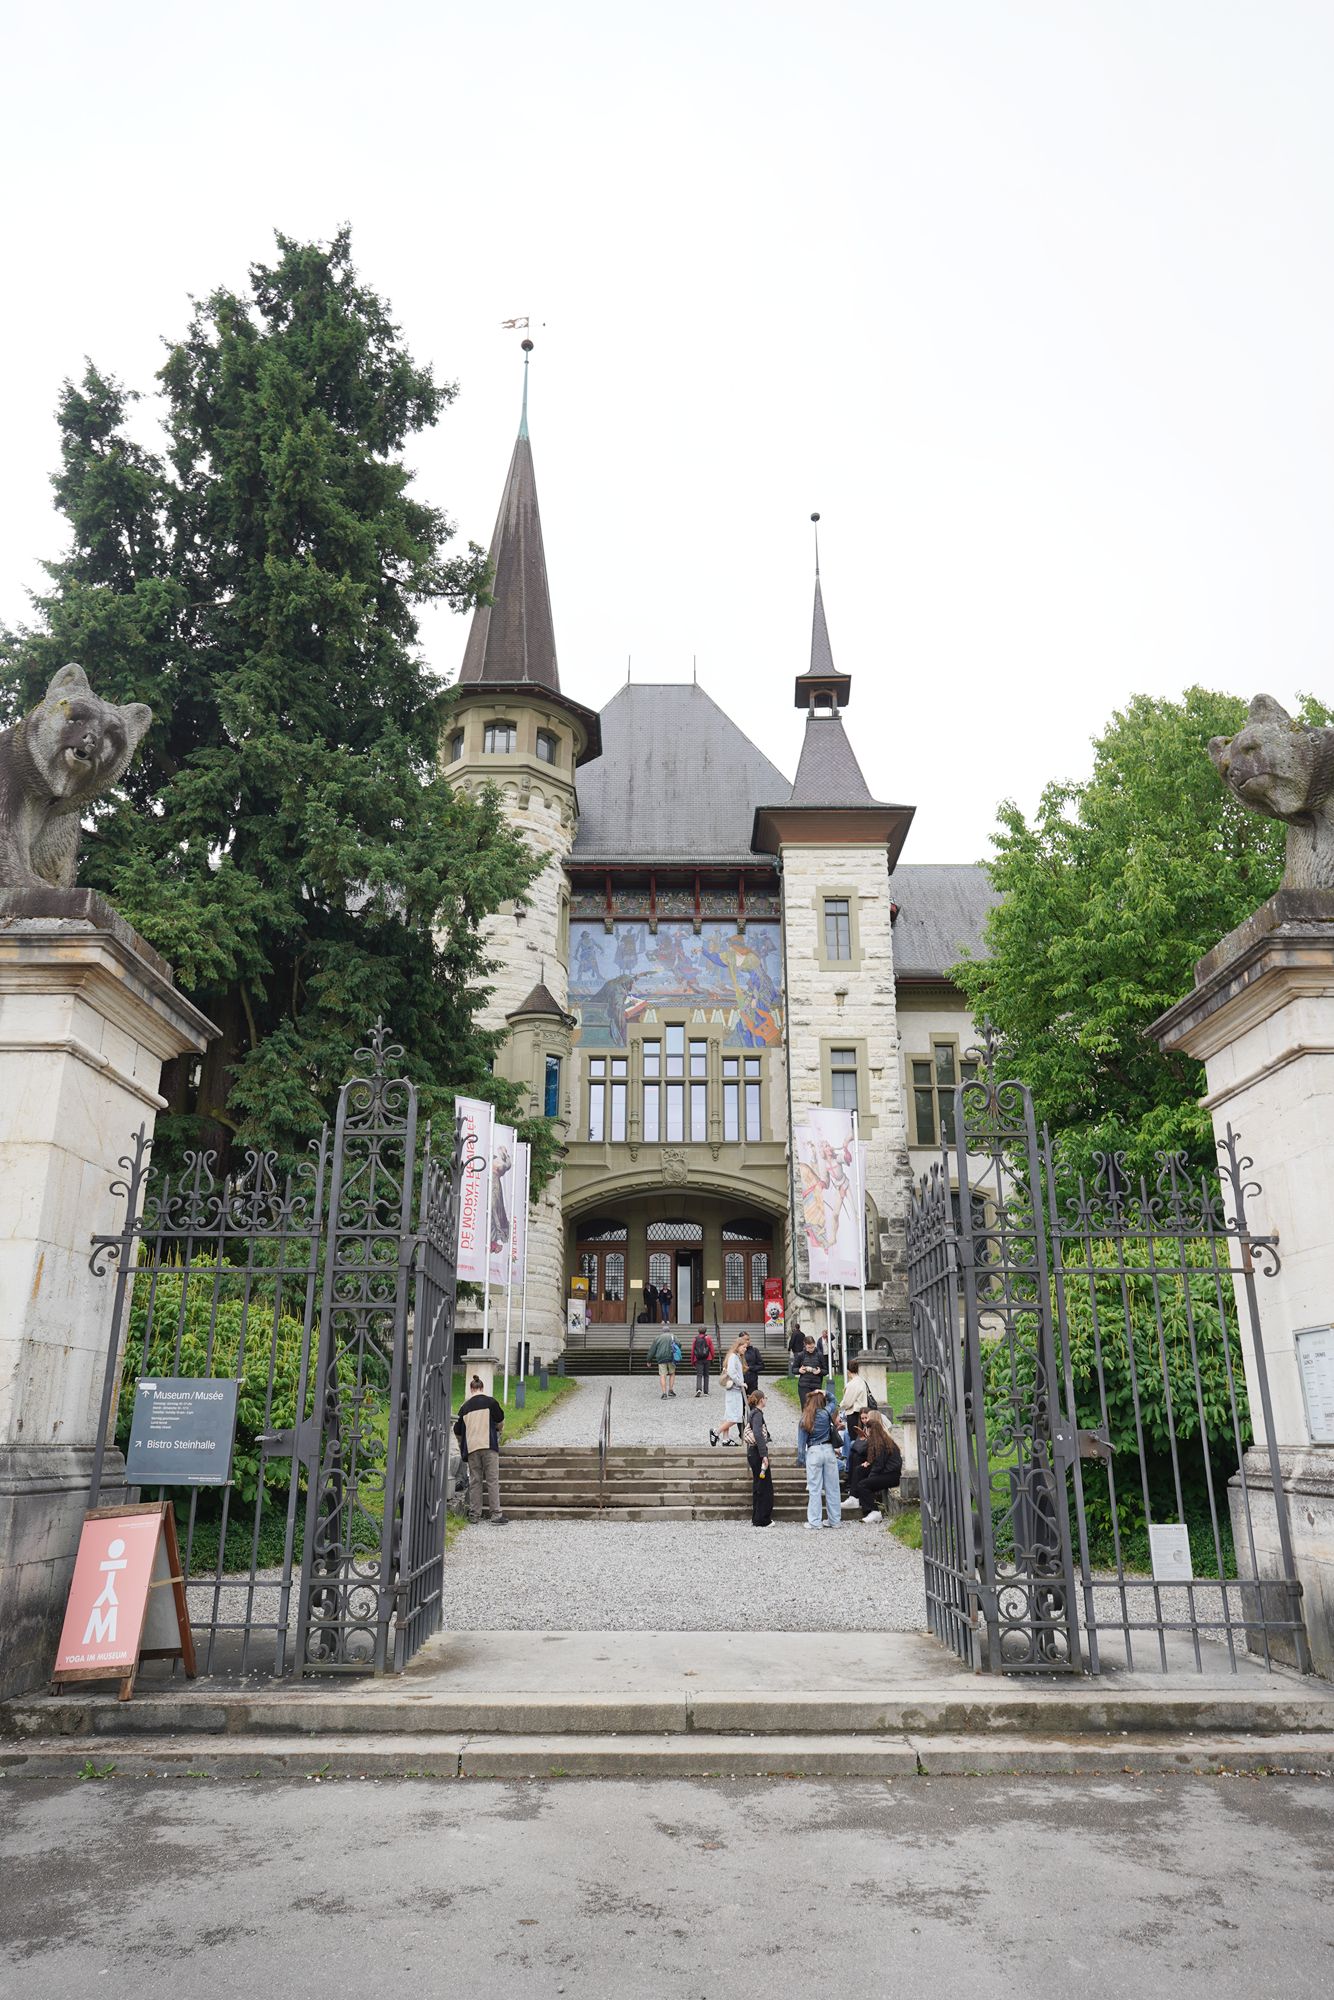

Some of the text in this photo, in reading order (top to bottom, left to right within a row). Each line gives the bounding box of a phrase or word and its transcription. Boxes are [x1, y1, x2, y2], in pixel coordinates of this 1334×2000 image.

[147, 1440, 216, 1450] Bistro Steinhalle
[65, 1651, 128, 1664] YOGA IM MUSEUM
